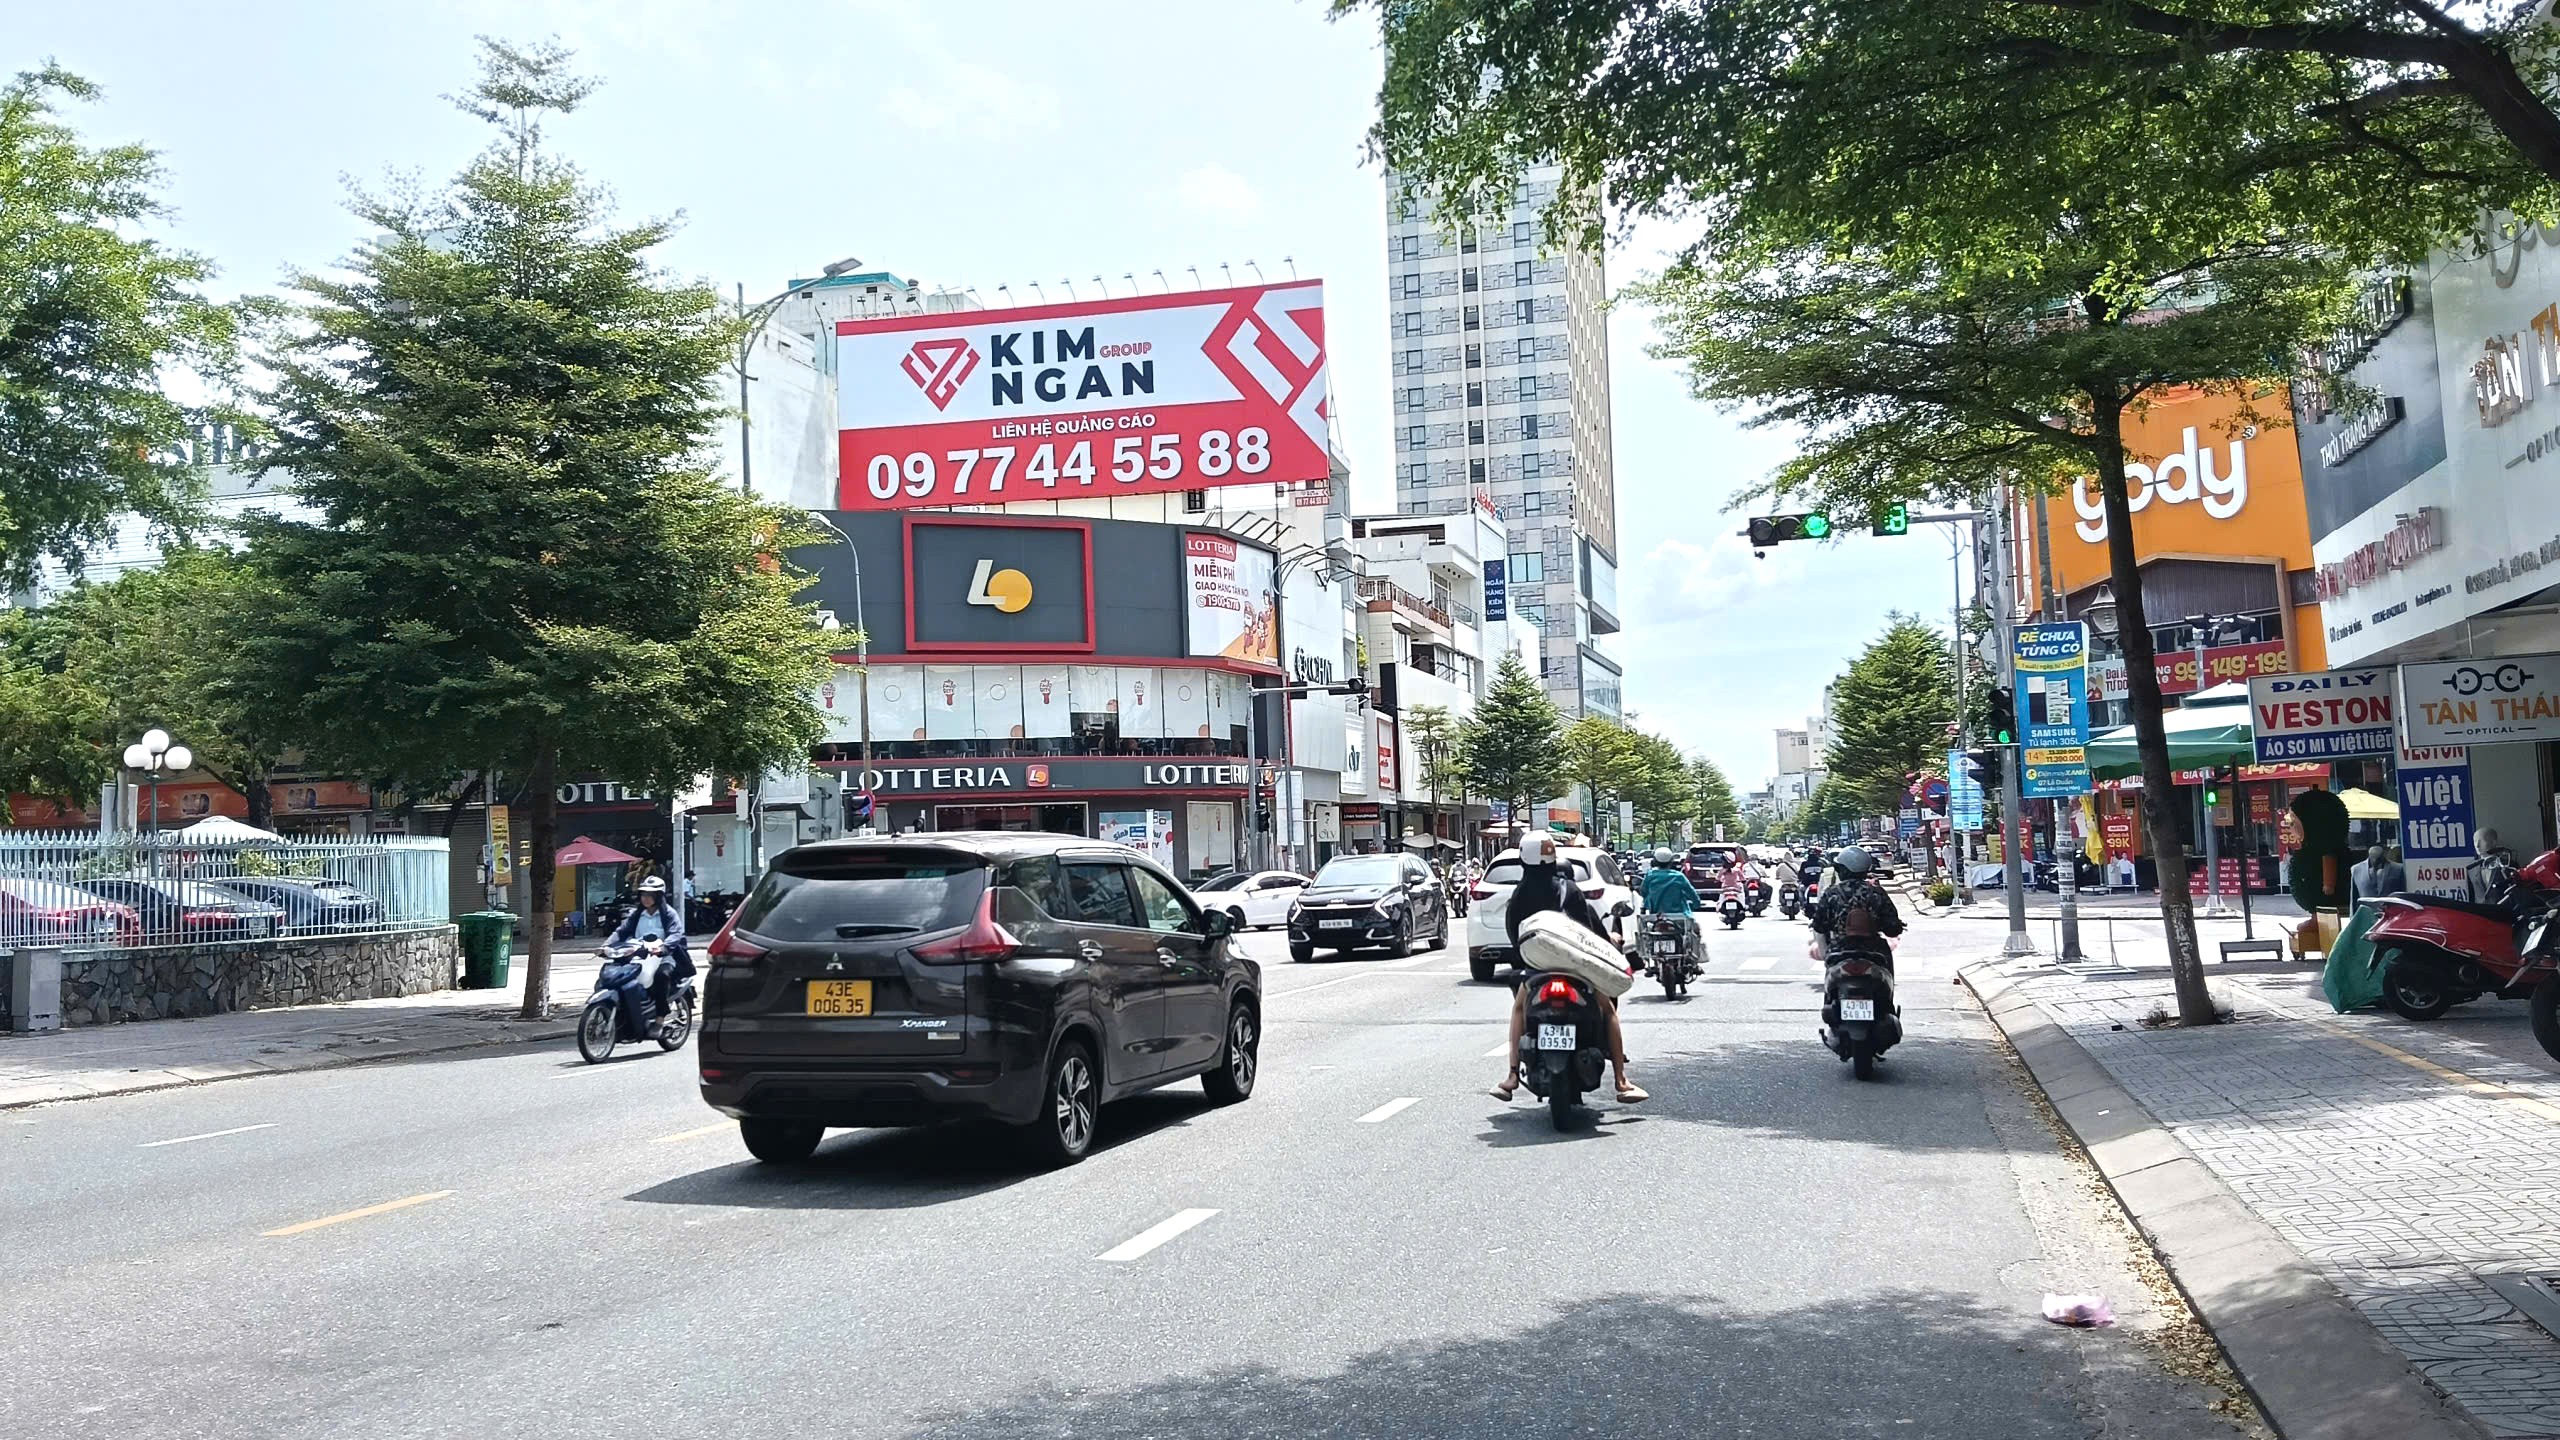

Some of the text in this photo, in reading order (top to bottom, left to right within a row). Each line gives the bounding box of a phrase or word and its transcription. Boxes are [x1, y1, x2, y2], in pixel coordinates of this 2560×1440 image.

[991, 327, 1152, 368] KIM GROUP
[991, 360, 1154, 406] NGAN
[992, 411, 1156, 439] LIÊN HỆ QUẢNG CÁO
[2339, 415, 2367, 454] TRANG
[867, 426, 1271, 499] 09 77 44 55 88
[2073, 426, 2247, 543] yody
[1188, 540, 1235, 557] LOTTERIA
[1194, 559, 1222, 578] MIỄN
[1195, 581, 1217, 591] GIAO
[2271, 671, 2378, 693] ĐẠI LÝ
[2259, 696, 2391, 730] VESTON
[2420, 698, 2478, 725] TÂN
[2031, 728, 2077, 738] SAMSUNG
[2467, 727, 2515, 736] OPTICAL
[2060, 737, 2081, 746] 305L
[2265, 738, 2284, 756] ÁO
[2288, 738, 2306, 755] SƠ
[2310, 738, 2325, 753] MI
[840, 767, 1011, 792] LOTTERIA
[2404, 774, 2462, 810] việt
[2408, 815, 2466, 849] tiến
[2107, 837, 2131, 848] 99K
[2435, 867, 2450, 881] SƠ
[2452, 867, 2465, 880] MI
[826, 982, 853, 997] 43E
[814, 999, 864, 1013] 006.35
[900, 1019, 948, 1028] XPANDER
[1544, 1025, 1571, 1037] 43-AA
[1540, 1037, 1574, 1049] 035.97
